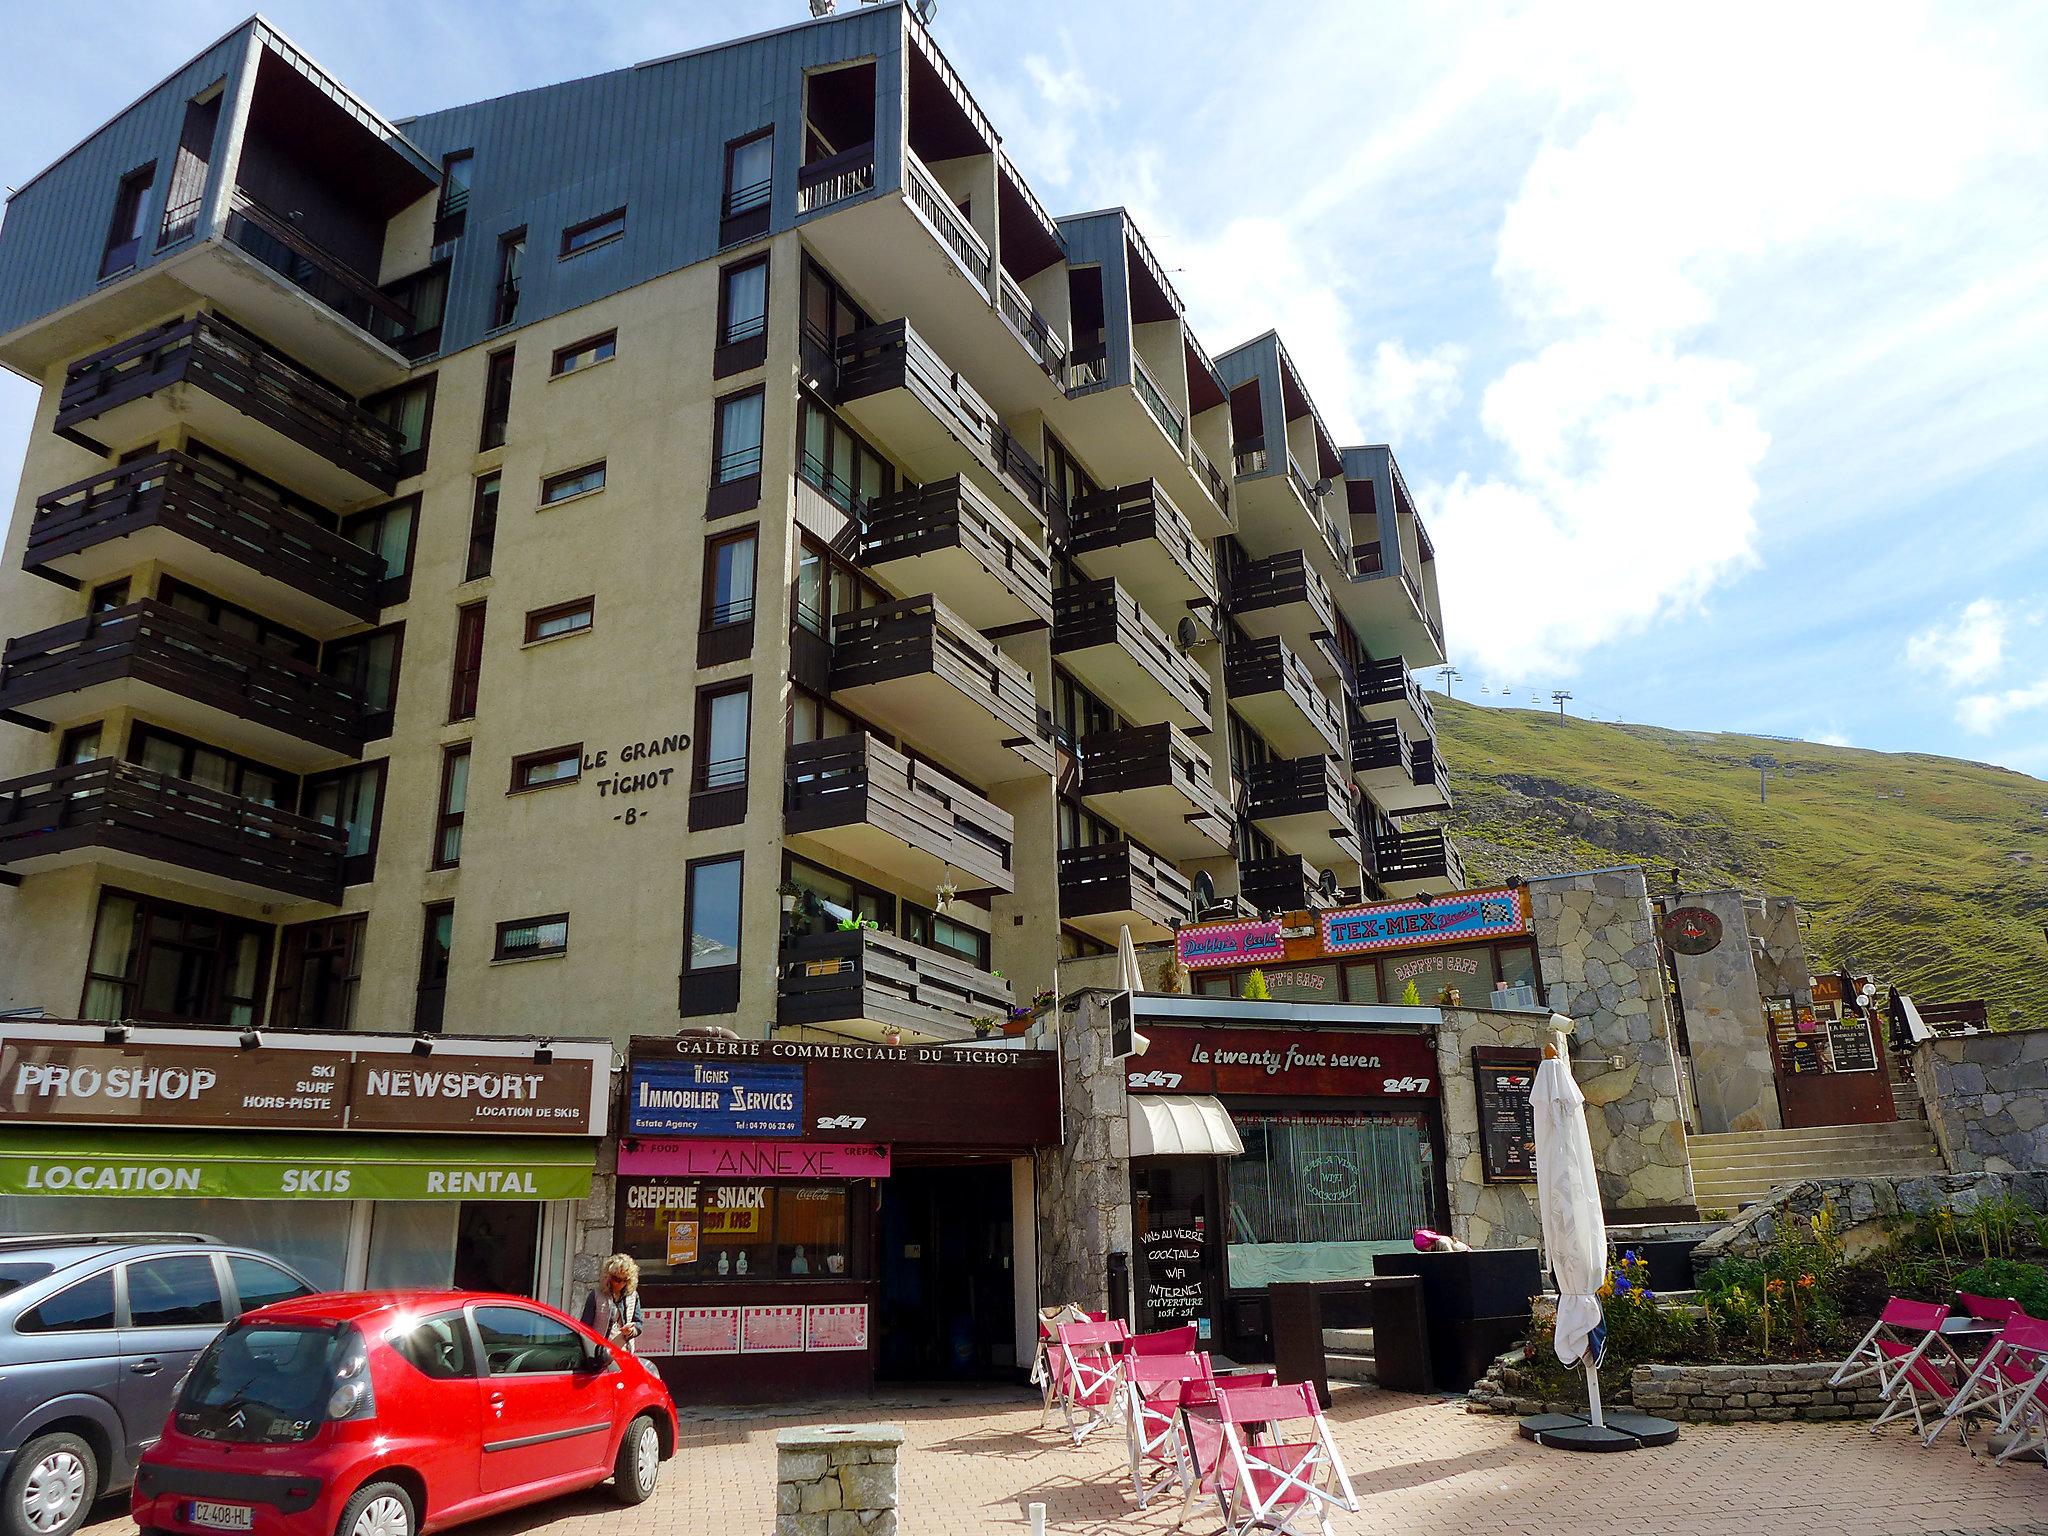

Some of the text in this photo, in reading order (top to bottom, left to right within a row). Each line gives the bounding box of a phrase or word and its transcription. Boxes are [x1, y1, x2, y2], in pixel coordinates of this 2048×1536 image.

[583, 734, 691, 770] LE GRAND
[1331, 912, 1438, 941] TEX-MEX
[1184, 936, 1237, 956] Daffy's
[1394, 956, 1478, 981] DAFFY'S CAFE
[676, 1040, 1020, 1064] GALERIE COMMERCIALE DU TICHOT
[1191, 1043, 1381, 1074] le twenty four seven
[311, 1065, 335, 1078] SKI
[1128, 1070, 1183, 1089] 247
[296, 1081, 334, 1094] SURF
[366, 1069, 544, 1100] NEWSPORT
[1382, 1076, 1431, 1093] 247
[243, 1096, 331, 1110] HORS-PISTE
[639, 1082, 720, 1110] IMMOBILIER
[476, 1106, 580, 1119] LOCATION DE SKIS
[635, 1119, 698, 1130] Estate Agency
[768, 1122, 777, 1130] 06
[777, 1122, 786, 1130] 32
[817, 1114, 867, 1130] 247
[651, 1144, 680, 1153] FOOD
[26, 1166, 201, 1190] LOCATION
[281, 1169, 351, 1193] SKIS
[427, 1171, 537, 1193] RENTAL
[717, 1186, 765, 1209] SNACK
[1140, 1228, 1204, 1244] VINS AU VERRE
[1148, 1248, 1200, 1260] COCKTAILS
[1165, 1267, 1186, 1280] WIFI
[1149, 1282, 1202, 1298] INTERNET
[1147, 1297, 1204, 1307] OUVERTURE
[1158, 1307, 1176, 1318] 10H
[293, 1419, 313, 1430] C1
